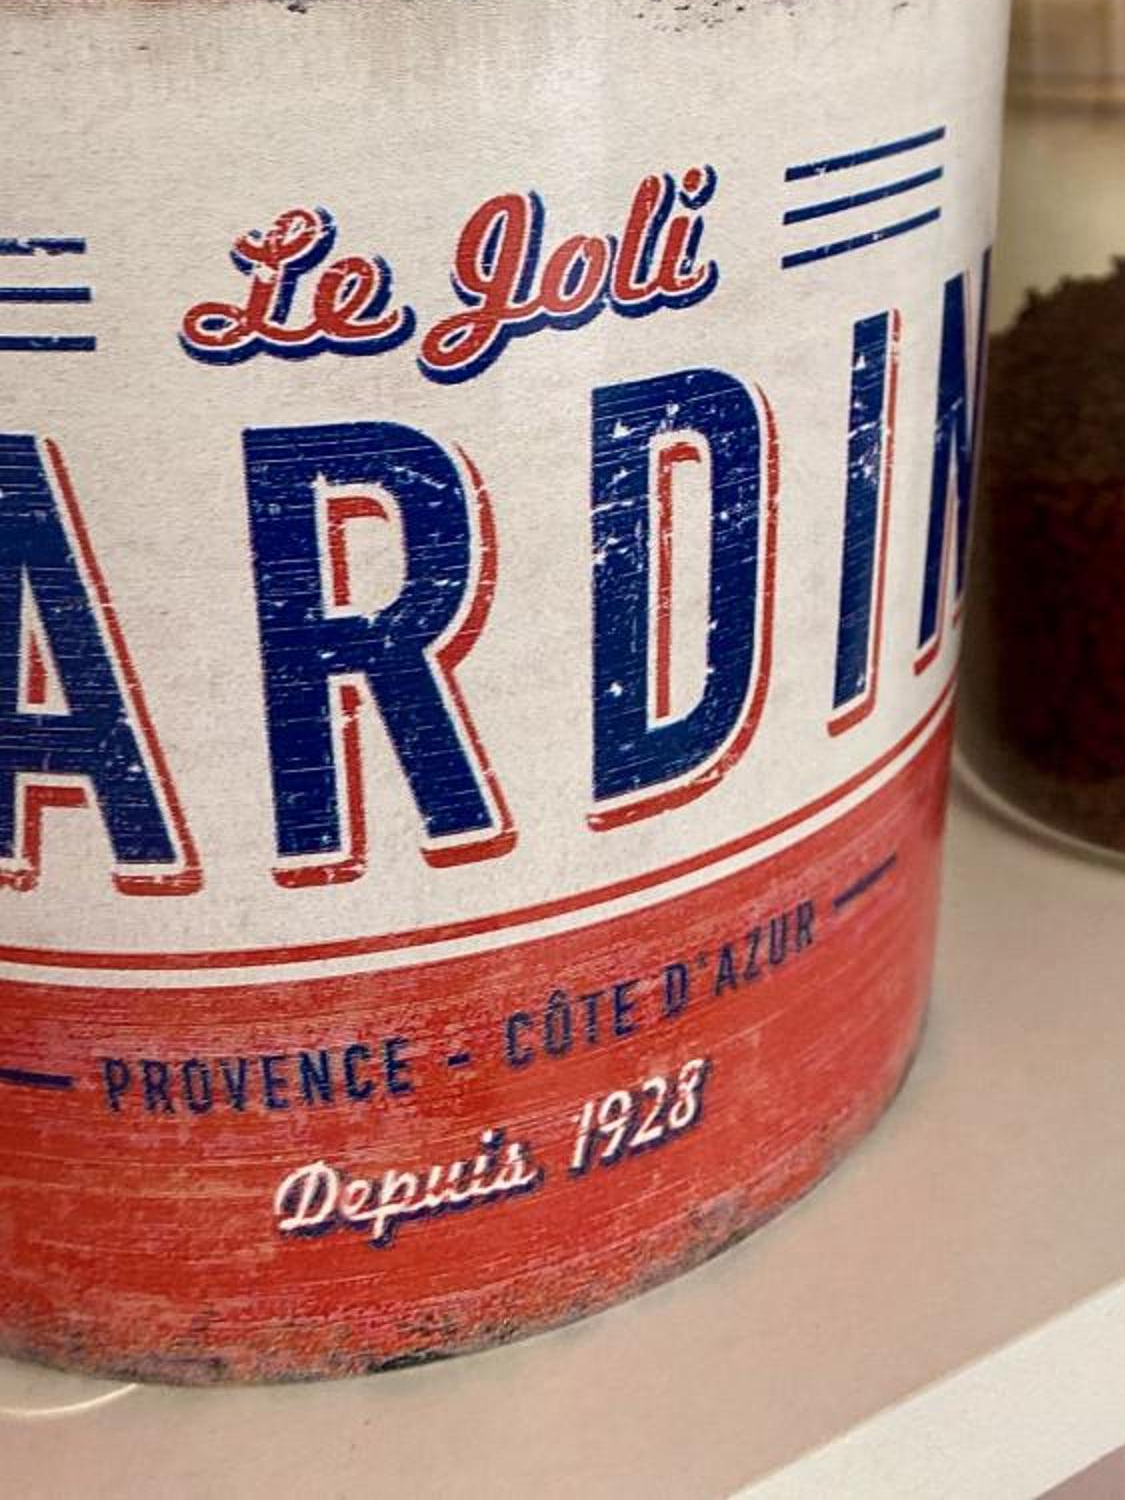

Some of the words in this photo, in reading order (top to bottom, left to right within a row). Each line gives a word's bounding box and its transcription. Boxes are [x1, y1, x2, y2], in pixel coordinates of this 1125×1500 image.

[180, 206, 416, 365] Le
[416, 165, 719, 385] Joli
[101, 1037, 414, 1114] PROVENCE
[503, 978, 641, 1069] CÔTE
[661, 899, 815, 1019] D'AZUR
[275, 1127, 544, 1249] Depuis
[567, 1056, 714, 1178] 1928
